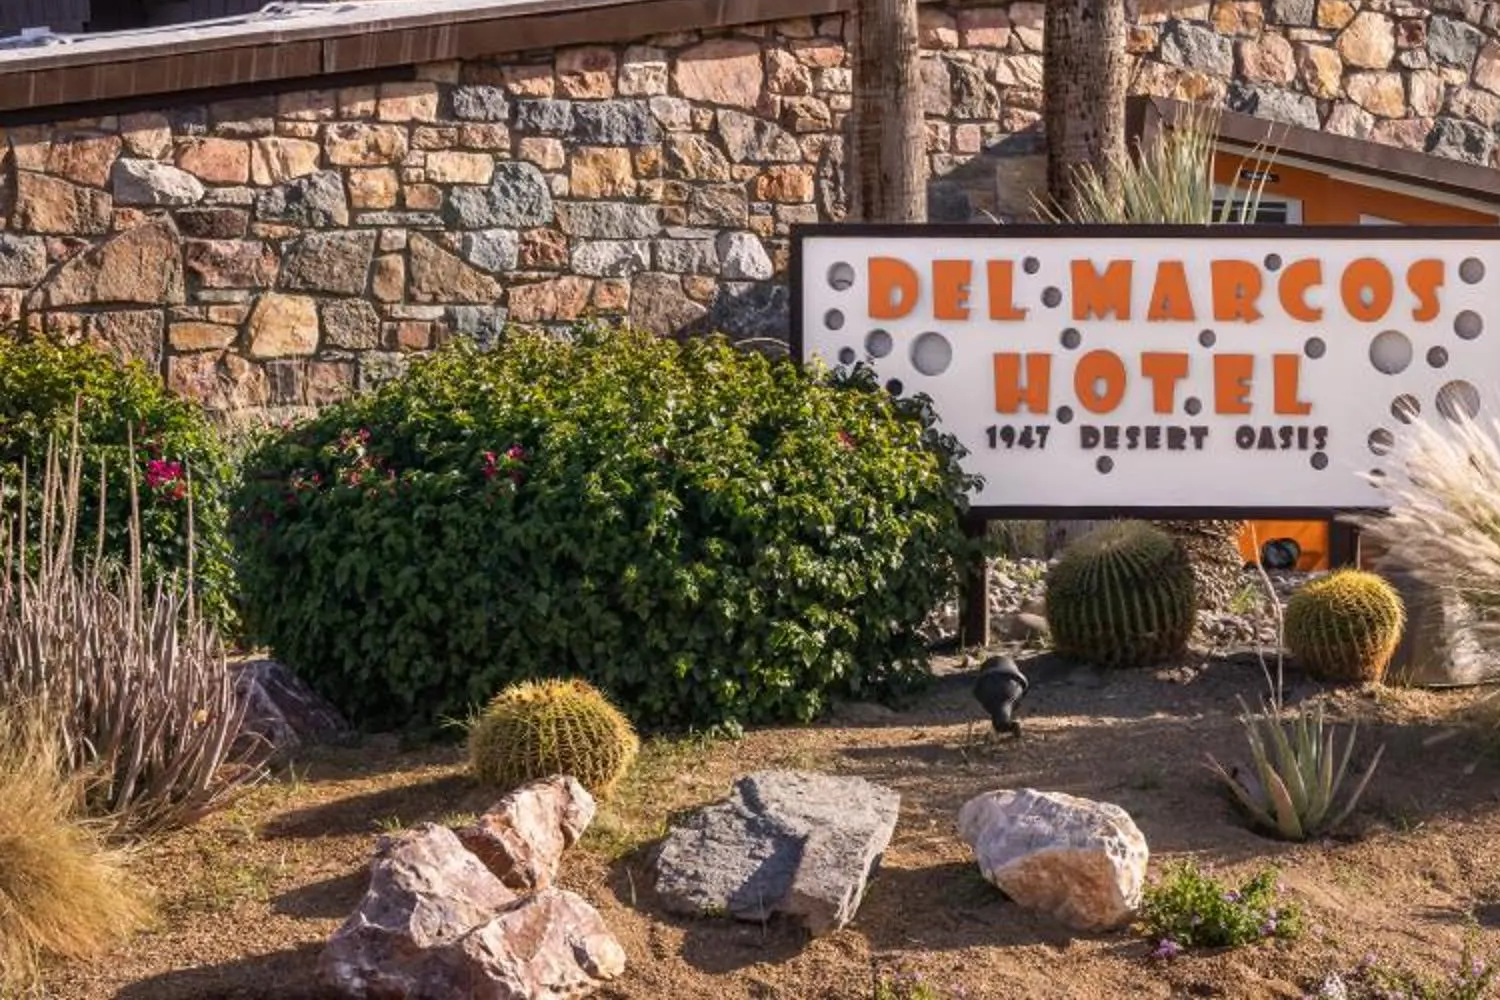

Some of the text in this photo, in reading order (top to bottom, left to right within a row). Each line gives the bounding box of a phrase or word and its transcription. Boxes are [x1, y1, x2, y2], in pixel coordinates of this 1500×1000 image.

[867, 256, 1446, 323] DEL MARCOS
[992, 350, 1312, 416] HOTEL
[984, 423, 1329, 452] 1947 DESERT OASIS
